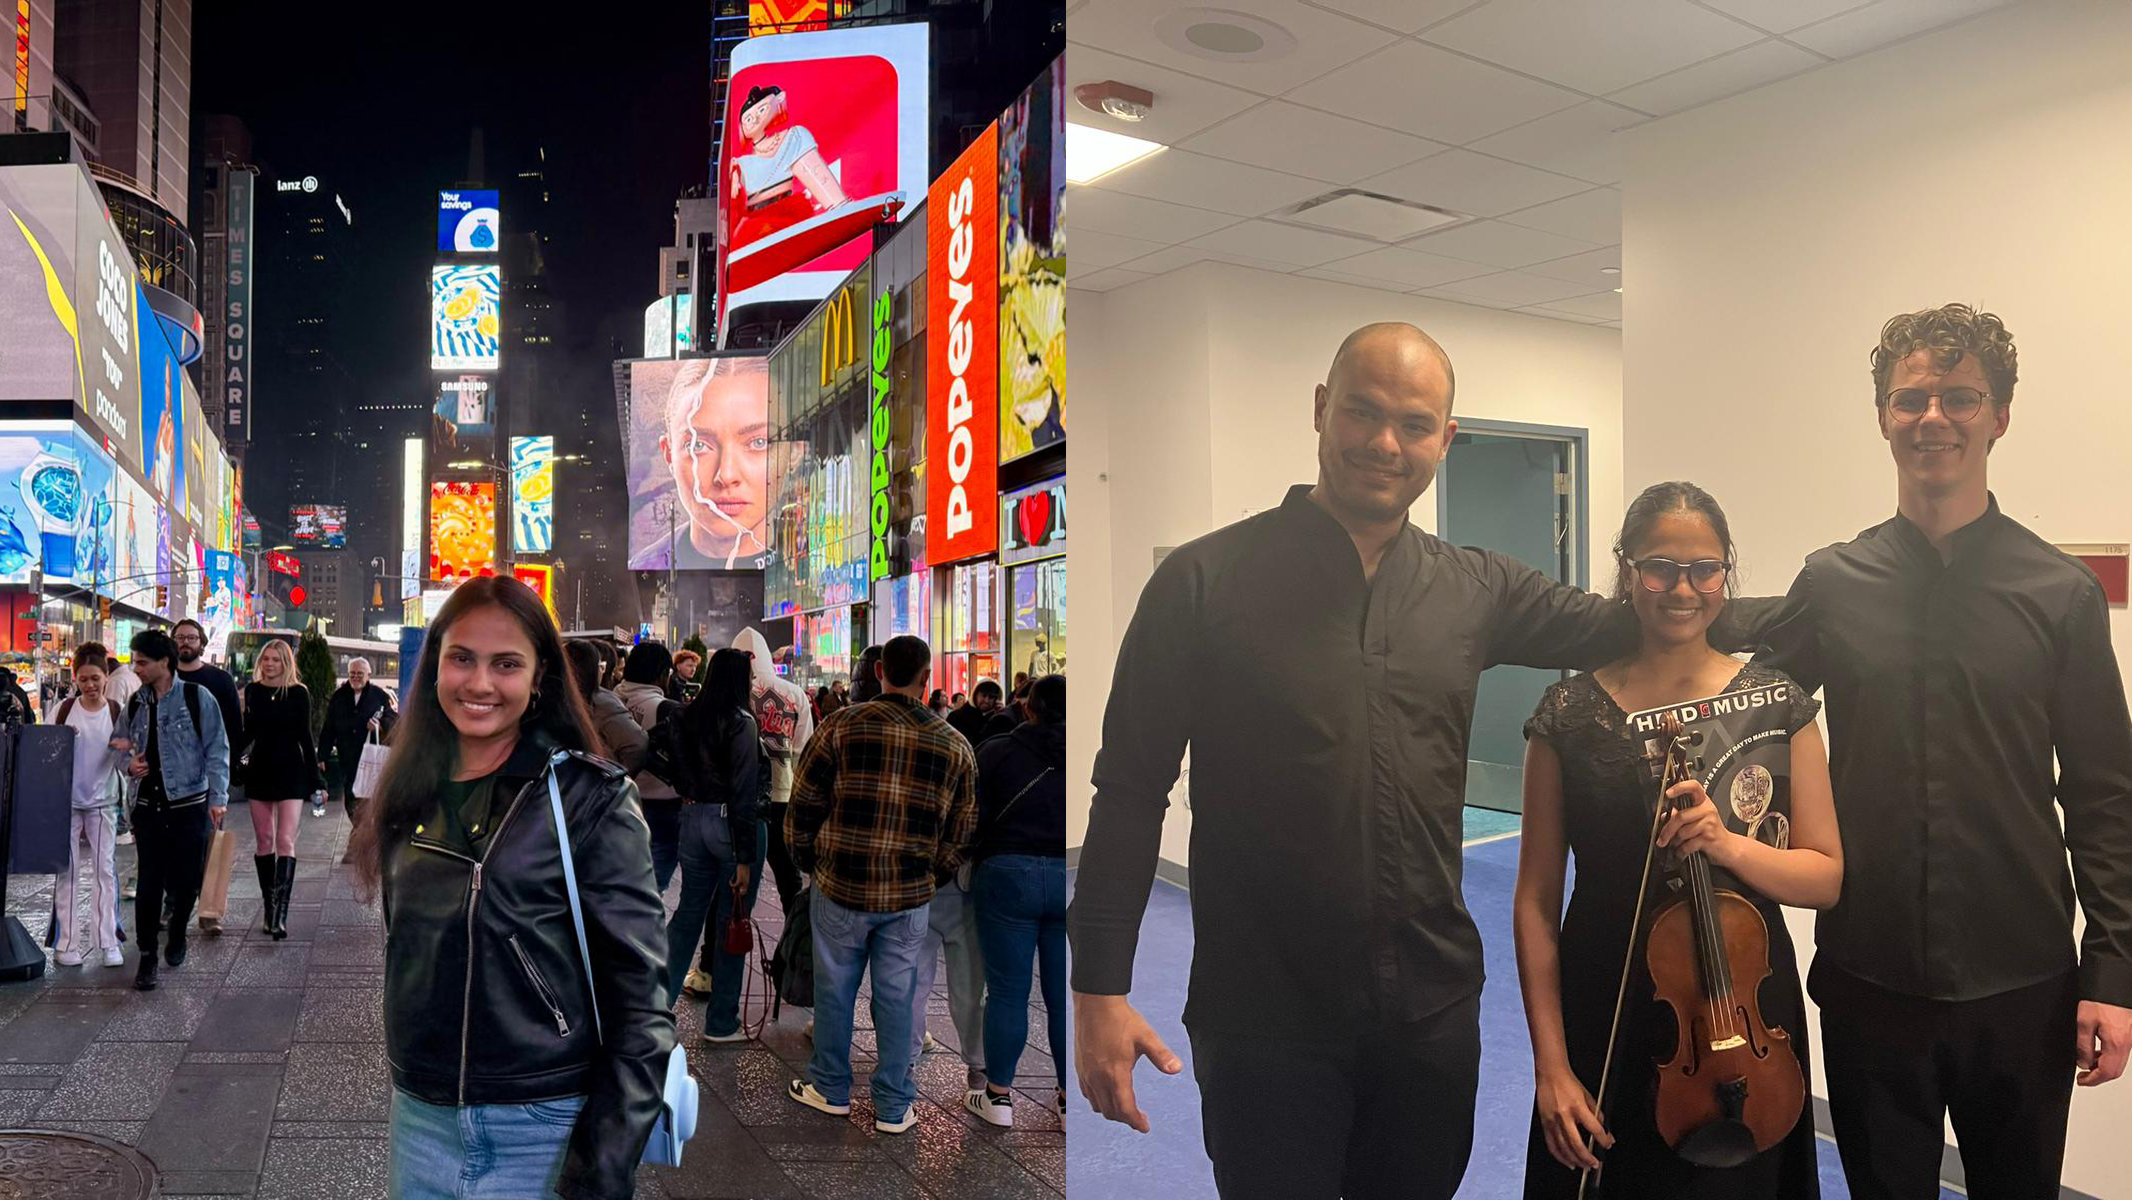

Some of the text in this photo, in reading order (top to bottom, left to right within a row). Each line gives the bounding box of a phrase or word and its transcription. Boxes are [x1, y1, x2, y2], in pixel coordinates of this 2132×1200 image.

[441, 191, 460, 202] Your
[441, 201, 472, 211] savings
[99, 239, 128, 314] COCO
[96, 278, 129, 355] JONES
[227, 186, 245, 426] TIMES SQUARE
[96, 388, 127, 440] pandora
[1713, 687, 1788, 717] MUSIC
[1715, 749, 1734, 768] GREAT
[1732, 741, 1745, 753] DAY
[1743, 737, 1753, 745] TO
[1752, 730, 1770, 741] MAKE
